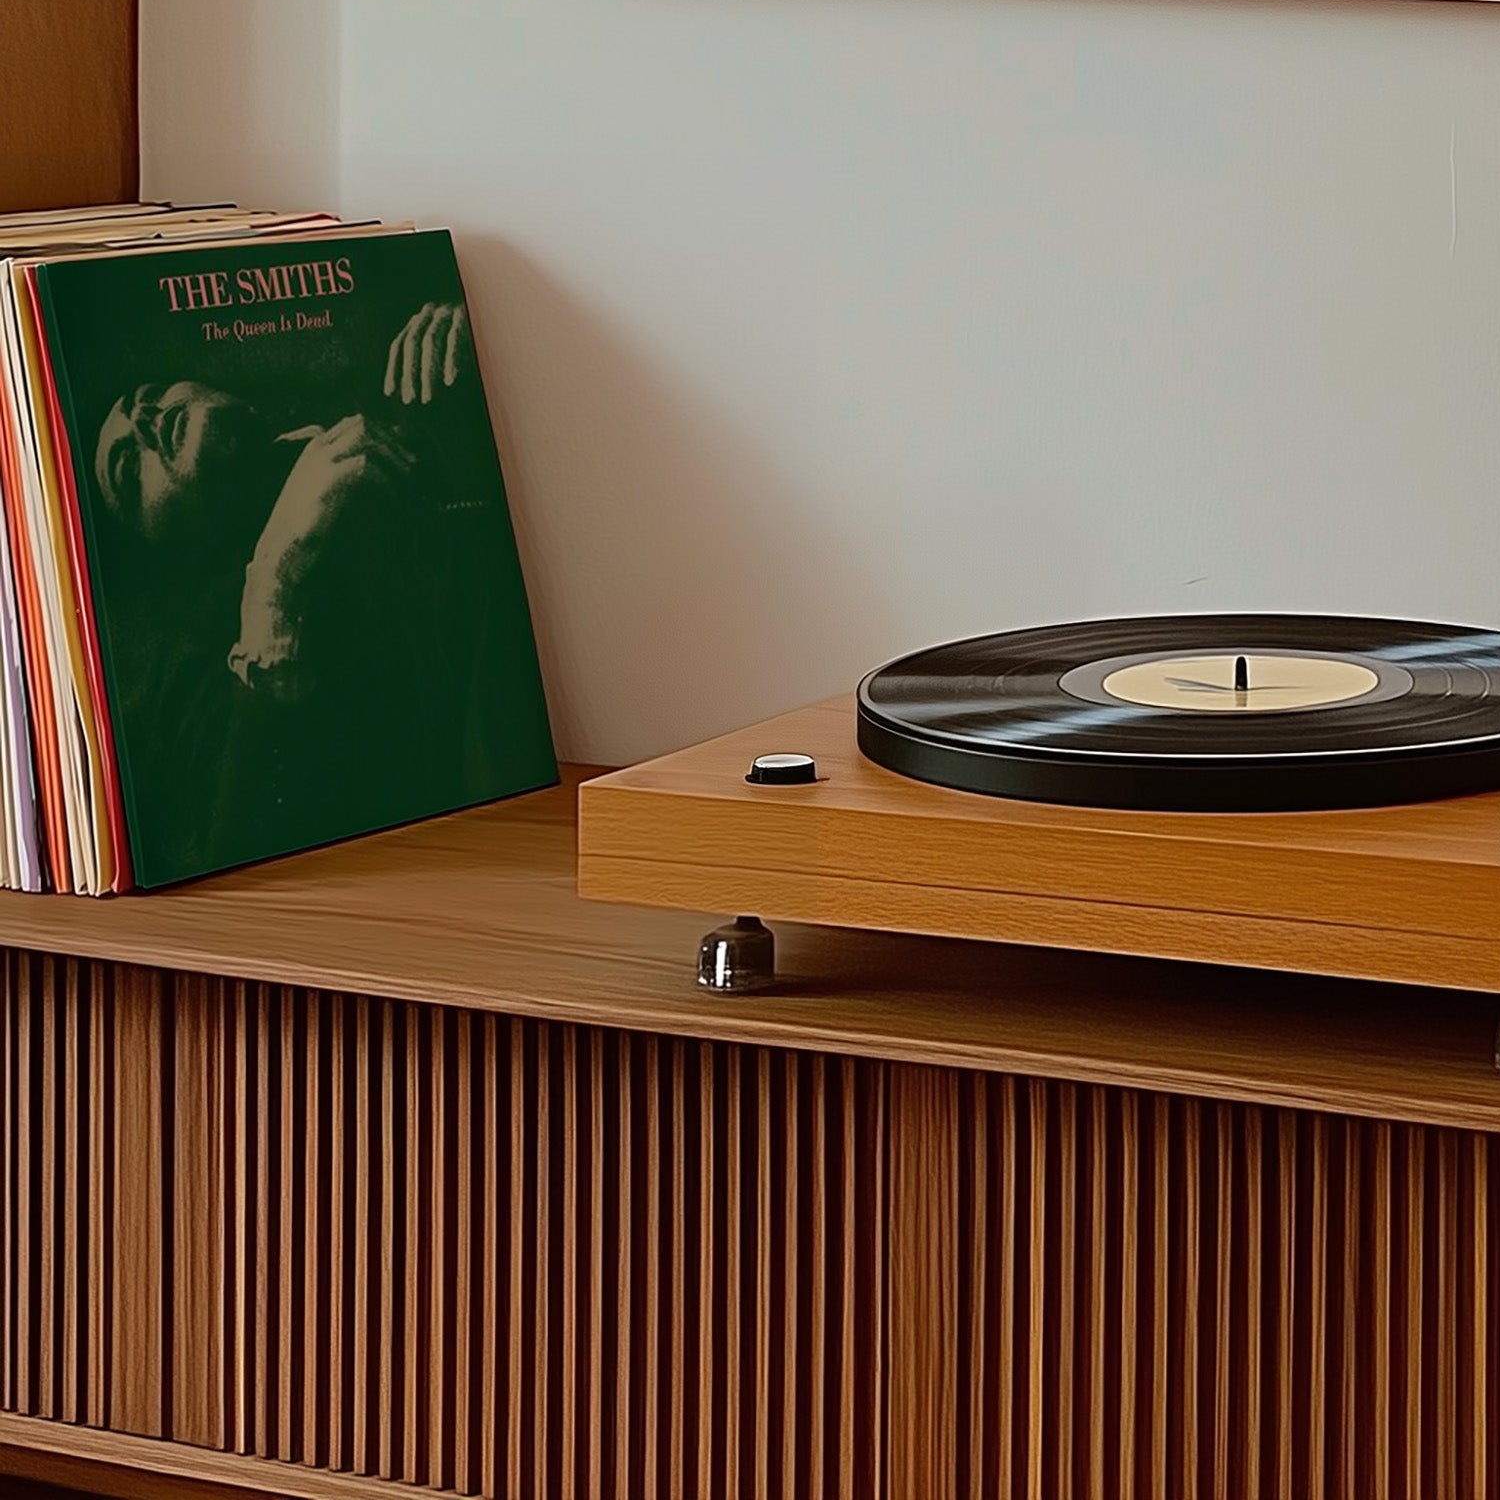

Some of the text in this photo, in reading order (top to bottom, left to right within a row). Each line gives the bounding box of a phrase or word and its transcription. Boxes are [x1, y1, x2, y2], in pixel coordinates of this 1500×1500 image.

[159, 257, 354, 312] THE SMITHS
[202, 310, 333, 342] The Queen Is Dead
